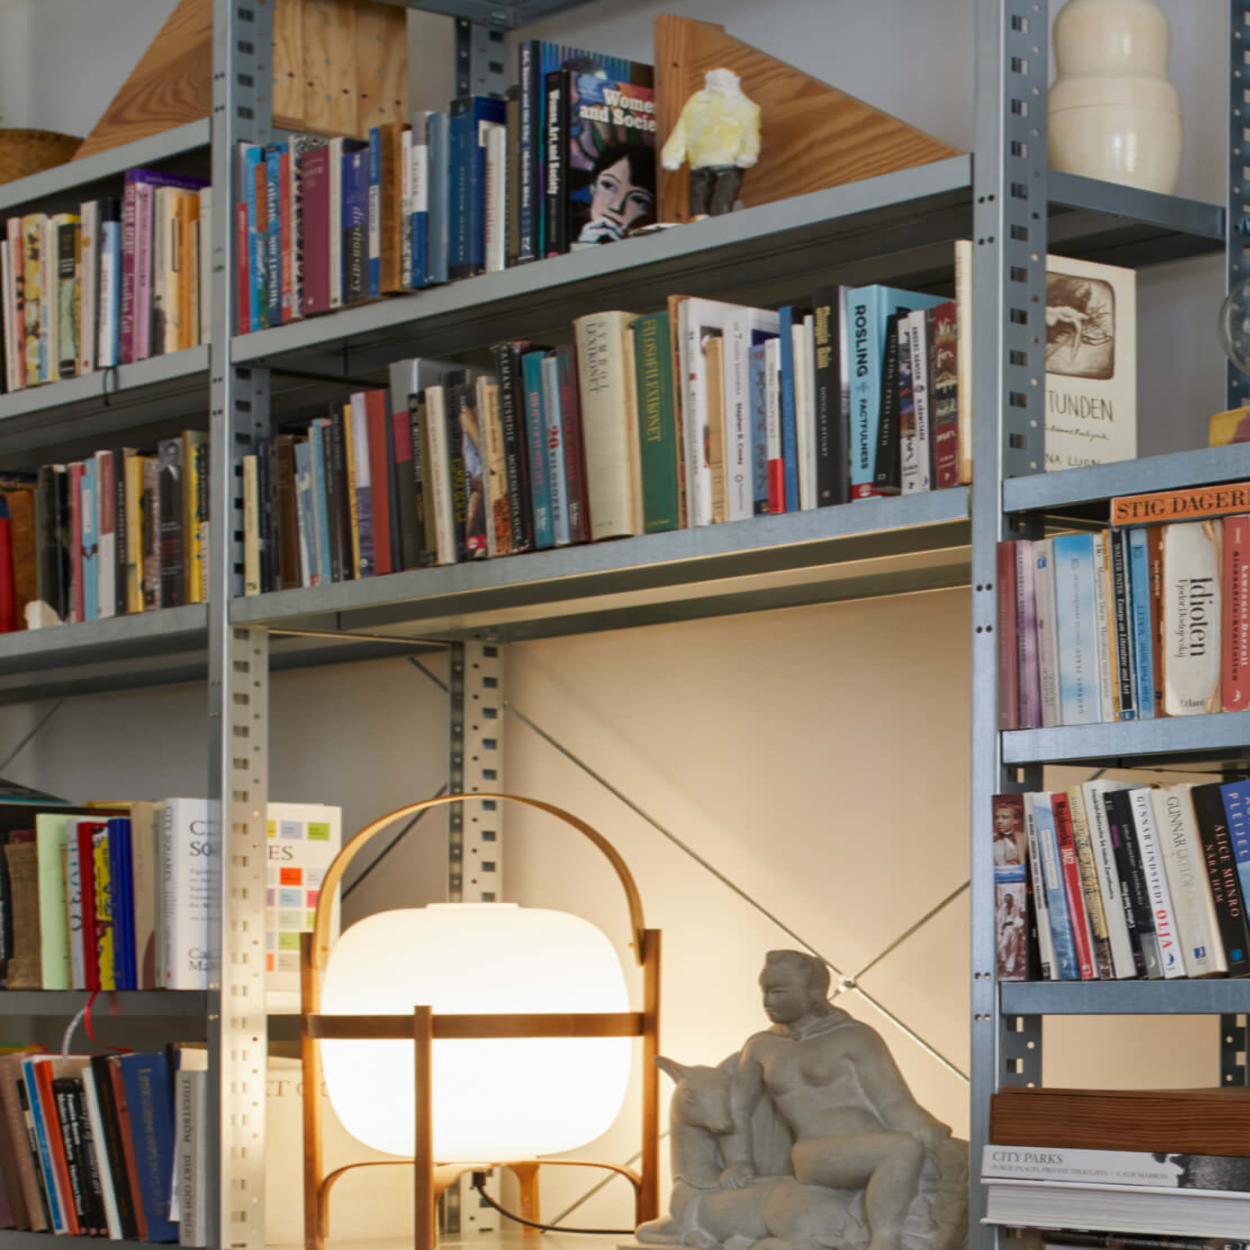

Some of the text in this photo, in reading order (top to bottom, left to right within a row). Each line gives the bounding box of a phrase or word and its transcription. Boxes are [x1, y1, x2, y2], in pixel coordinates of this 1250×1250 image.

[548, 90, 560, 126] Women,
[580, 104, 657, 132] and Socie
[549, 145, 559, 160] and
[547, 163, 559, 194] Society
[586, 322, 599, 393] LEXIKONET
[855, 304, 868, 377] ROSLING
[642, 319, 661, 442] FILOSOFILEXIKONET
[1047, 390, 1114, 423] TUNDEN
[859, 398, 868, 469] FACTFULNESS
[1116, 501, 1165, 521] STIG
[1189, 577, 1213, 657] Idioten
[1228, 792, 1249, 858] PLEIJEL
[1061, 848, 1075, 865] JAG!
[1135, 796, 1163, 905] GUNNAR LINDSTEDT
[1205, 844, 1223, 903] NÄRA HEM
[1214, 824, 1240, 918] ALICE MUNRO
[1155, 909, 1173, 949] OLJA
[992, 1151, 1063, 1165] CITY PARKS
